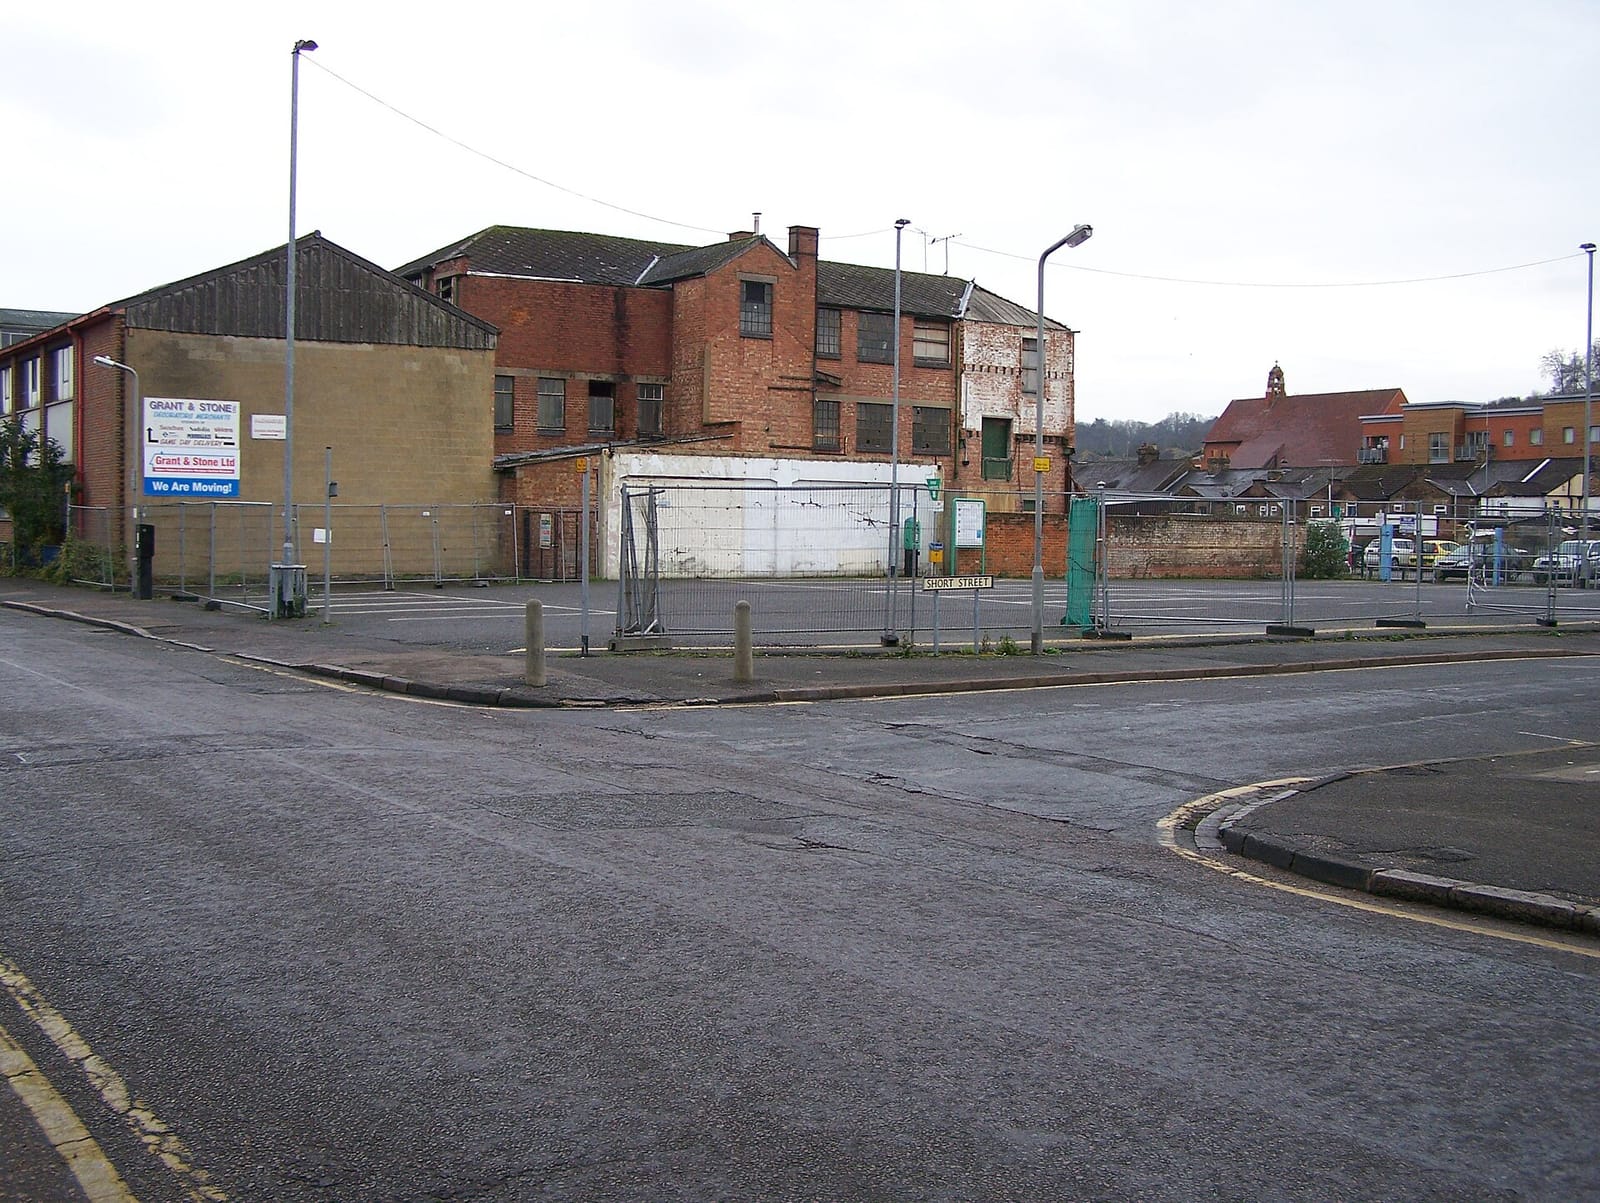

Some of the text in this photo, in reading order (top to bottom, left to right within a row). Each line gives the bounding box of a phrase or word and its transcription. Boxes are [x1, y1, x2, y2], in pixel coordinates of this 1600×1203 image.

[149, 400, 184, 411] GRANT
[188, 402, 195, 411] &
[199, 402, 232, 413] STONE
[155, 456, 235, 466] Grant & Stone Ltd
[152, 481, 232, 494] We Are Moving!
[927, 578, 989, 588] SHORT STREET
